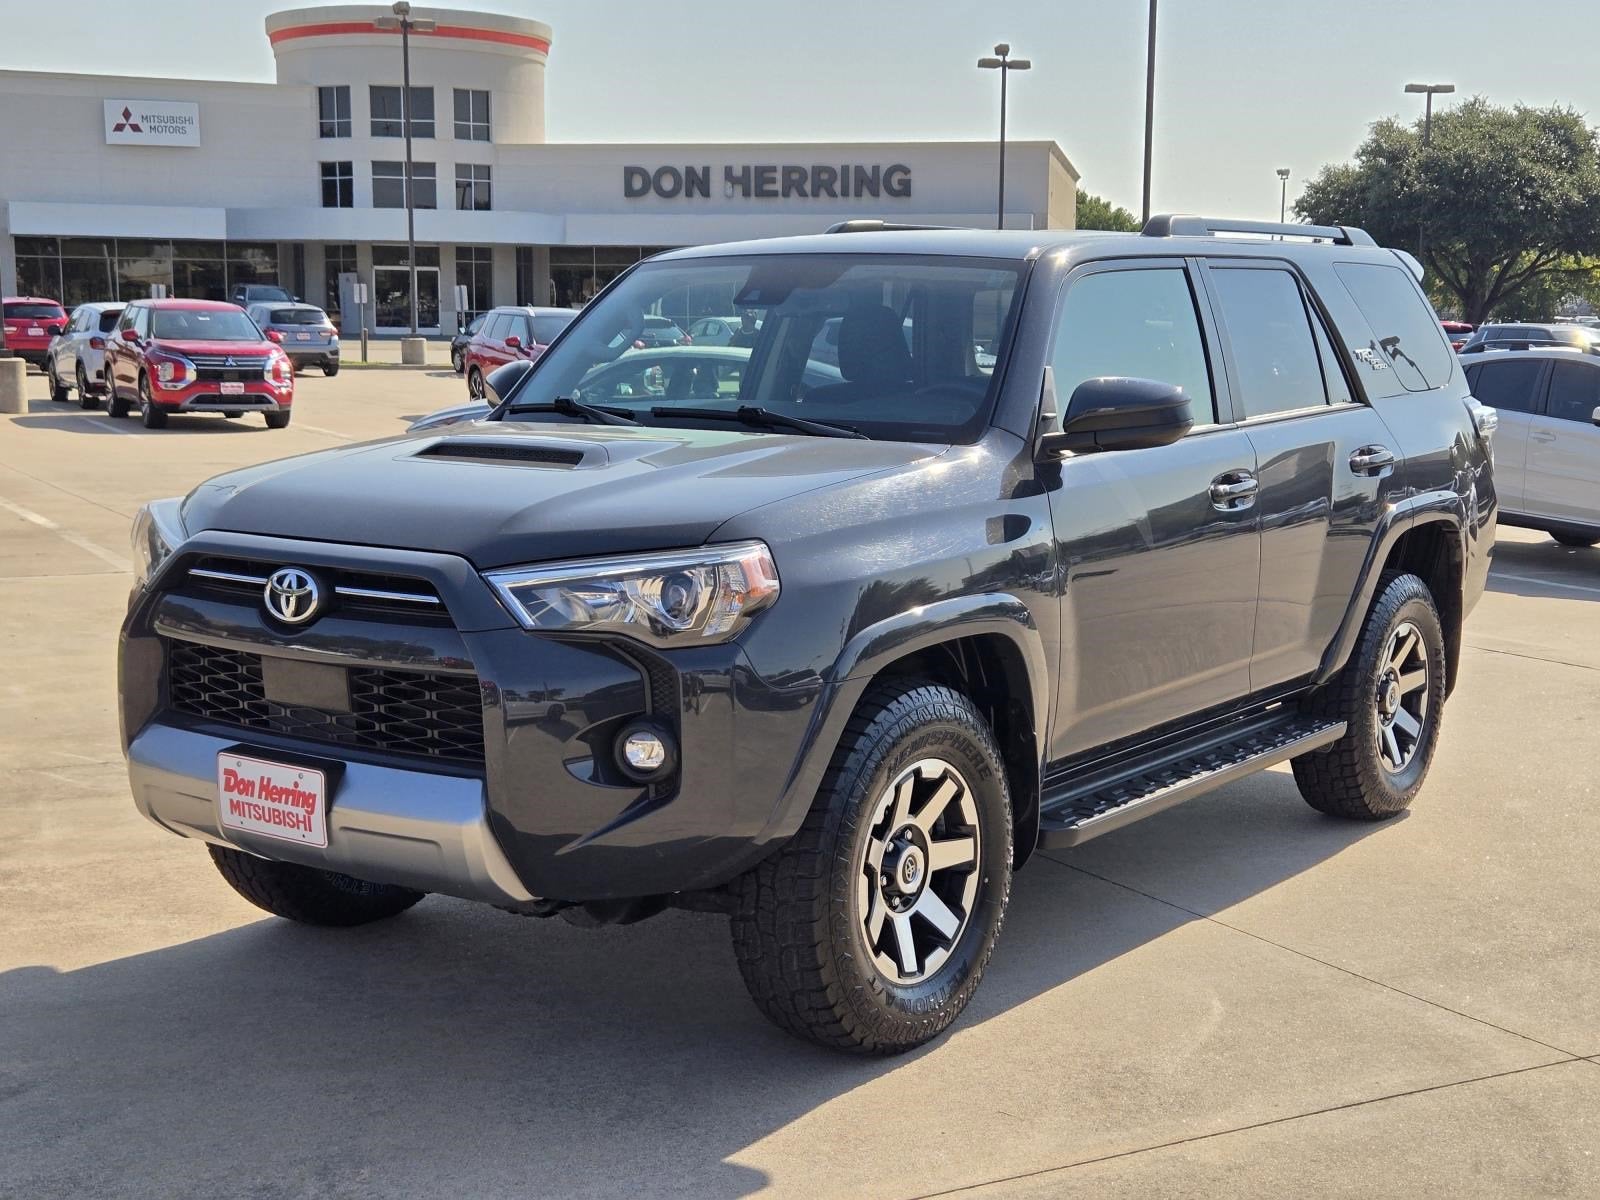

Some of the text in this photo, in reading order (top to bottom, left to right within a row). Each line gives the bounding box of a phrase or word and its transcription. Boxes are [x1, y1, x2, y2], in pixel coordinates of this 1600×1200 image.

[141, 114, 194, 125] MITSUBISHI
[149, 125, 187, 135] MOTORS
[623, 163, 912, 198] DON HERRING
[223, 768, 317, 816] Don Herring
[229, 798, 313, 832] MITSUBISHI
